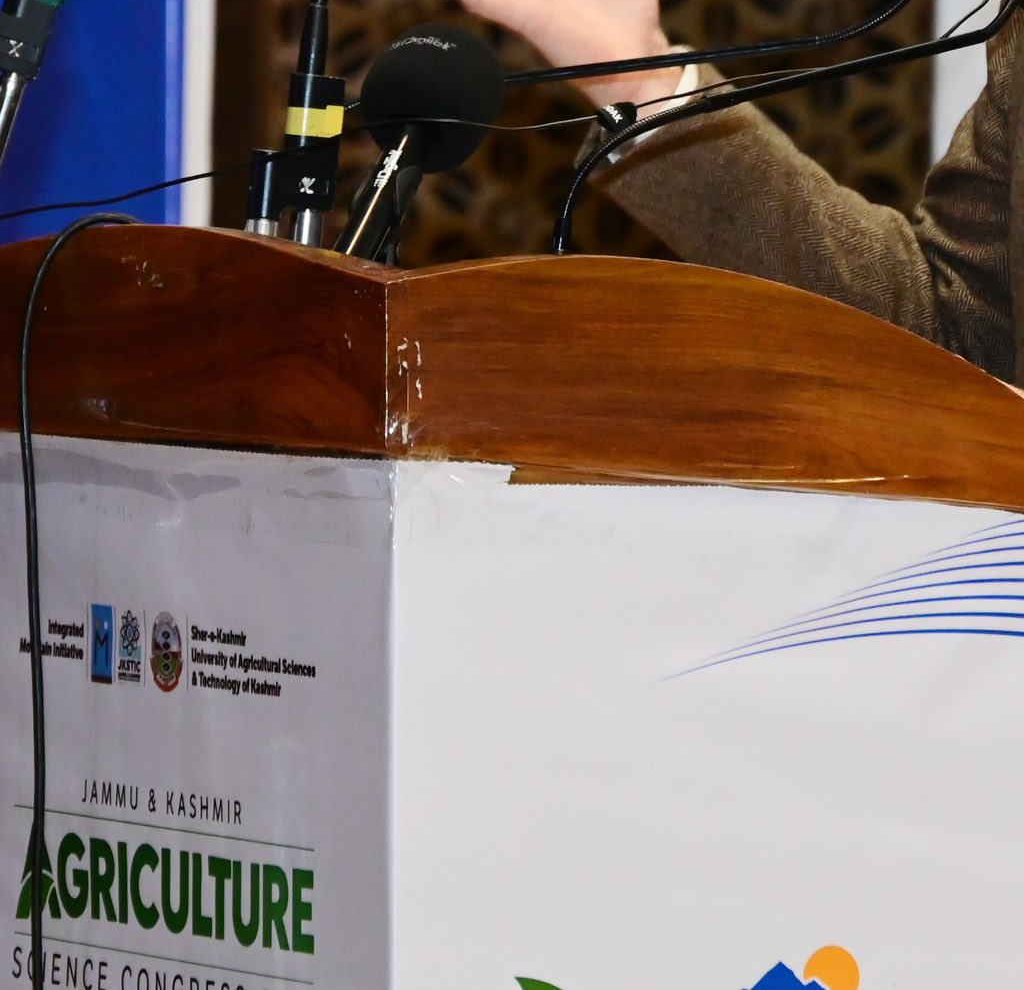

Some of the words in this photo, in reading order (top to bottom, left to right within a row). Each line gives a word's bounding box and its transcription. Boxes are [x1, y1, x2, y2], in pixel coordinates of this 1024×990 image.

[48, 619, 84, 639] Integrated
[20, 638, 52, 656] Moain
[53, 642, 83, 660] Initiative
[191, 649, 228, 670] University
[229, 653, 237, 669] of
[238, 654, 281, 674] Agricultural
[282, 659, 316, 677] Sciences
[192, 671, 197, 686] &
[199, 672, 240, 695] Technology
[242, 678, 250, 694] of
[251, 679, 281, 697] Kashmir
[81, 780, 139, 810] JAMMU
[148, 788, 157, 813] &
[166, 791, 242, 825] KASHMIR
